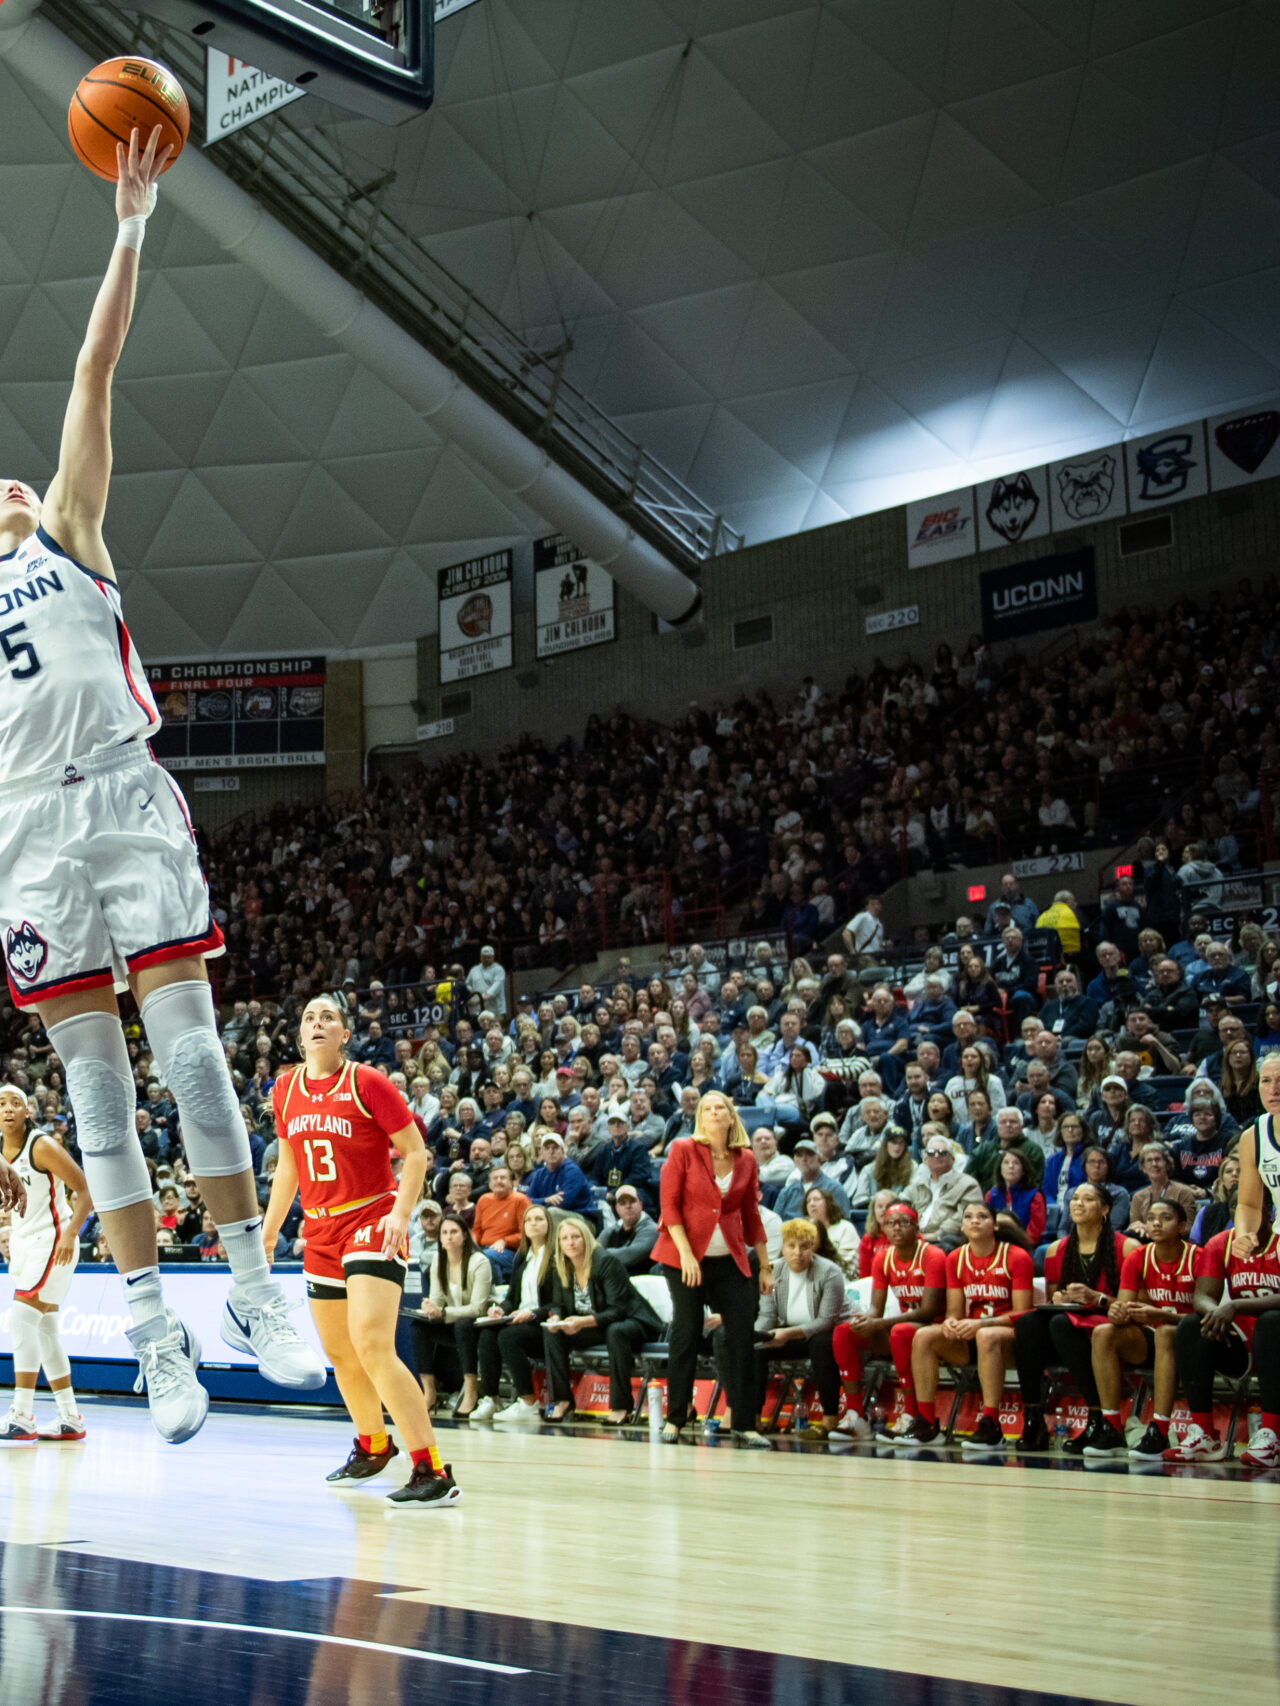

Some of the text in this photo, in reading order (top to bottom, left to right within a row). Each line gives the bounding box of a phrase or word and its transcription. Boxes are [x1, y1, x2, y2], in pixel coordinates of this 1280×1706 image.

[220, 83, 296, 129] CHAMPIO
[922, 506, 961, 526] BIG
[917, 516, 971, 541] EAST
[445, 552, 509, 587] JIM CALHOUN
[992, 570, 1083, 611] UCONN
[888, 609, 917, 627] 220
[544, 615, 606, 644] JIM CALHOUN
[171, 659, 312, 679] CHAMPIONSHIP
[170, 677, 254, 690] FINAL FOUR
[238, 755, 319, 766] BASKETBALL
[221, 778, 236, 789] 10
[1049, 853, 1084, 872] 221
[390, 1005, 443, 1025] SEC 120
[287, 1113, 352, 1139] MARYLAND
[303, 1139, 337, 1182] 13
[963, 1284, 1008, 1299] MARYLAND
